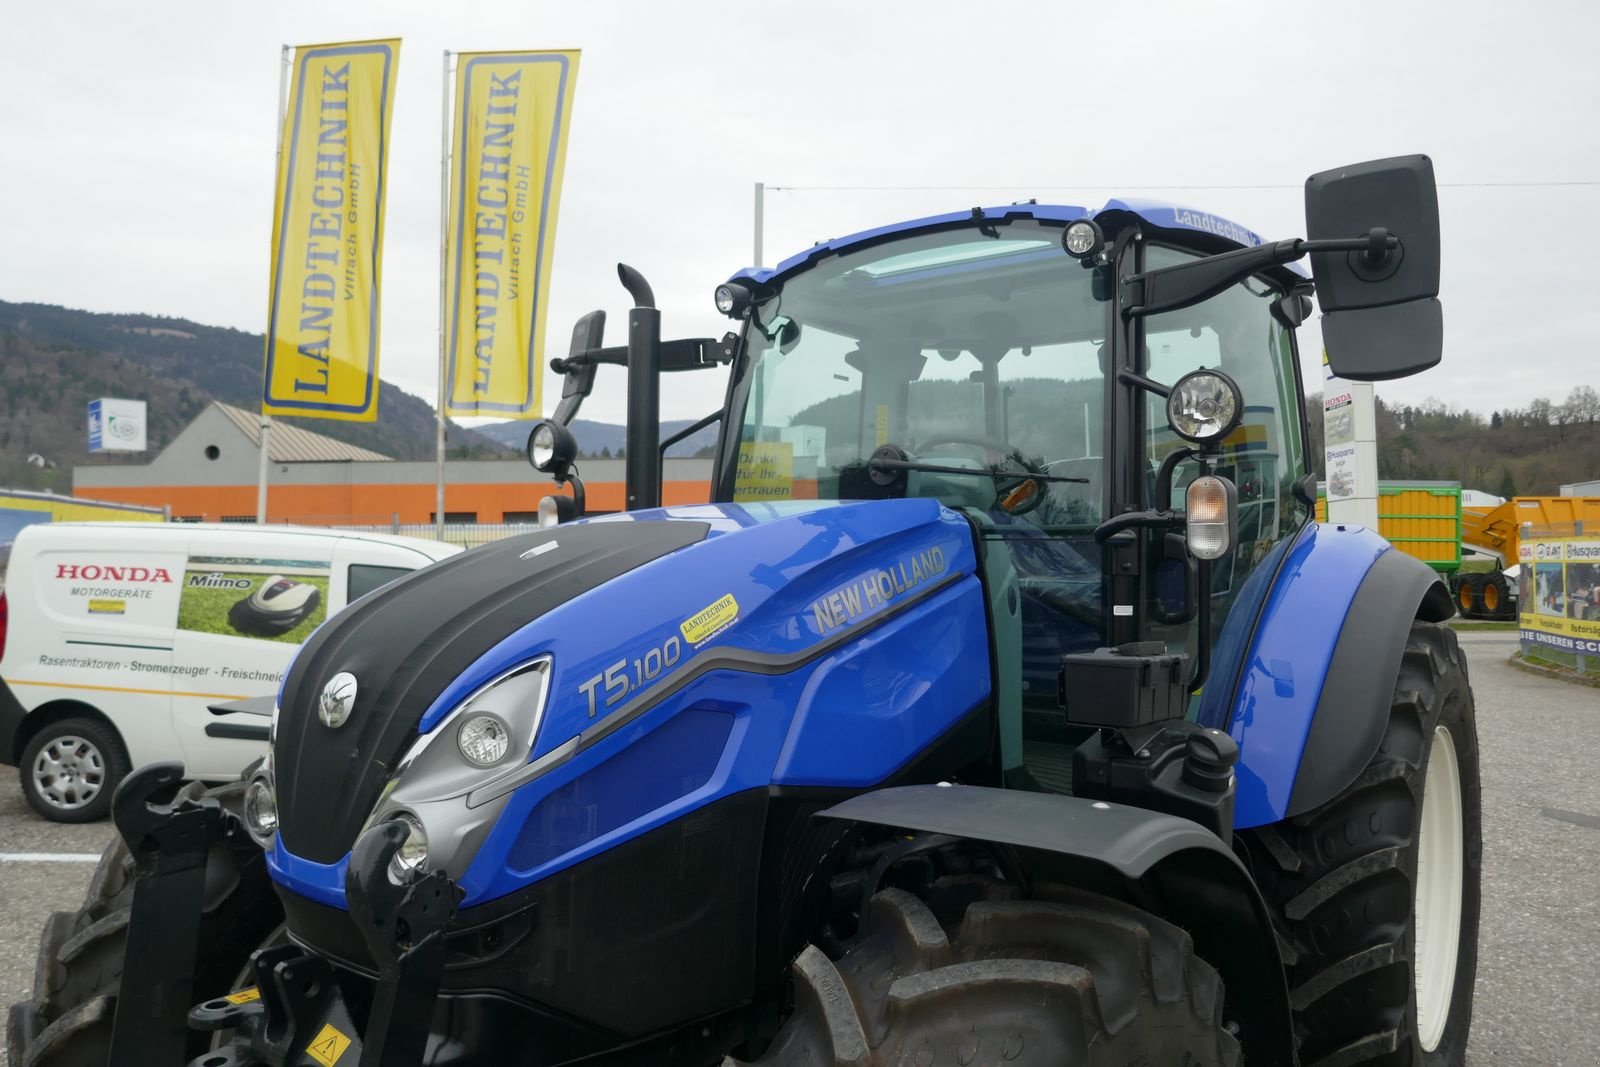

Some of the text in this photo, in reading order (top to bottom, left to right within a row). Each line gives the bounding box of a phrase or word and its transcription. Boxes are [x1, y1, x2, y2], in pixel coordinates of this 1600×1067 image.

[294, 60, 351, 396] LANDTECHNIK
[344, 163, 361, 301] Villach GmbH
[474, 68, 523, 395] LANDTECHNIK
[508, 165, 531, 300] Villach GmbH
[1325, 393, 1352, 407] HONDA
[734, 485, 790, 496] ertrauen
[56, 564, 173, 583] HONDA
[189, 572, 251, 589] Miimo
[71, 587, 153, 600] MOTORGERÄTE
[812, 546, 945, 634] NEW HOLLAND
[683, 597, 733, 634] LANDTECHNIK
[1536, 633, 1573, 649] UNSEREN
[39, 654, 120, 671] Rasentraktoren
[130, 661, 210, 677] Stromerzeuger
[578, 635, 681, 719] T5.100
